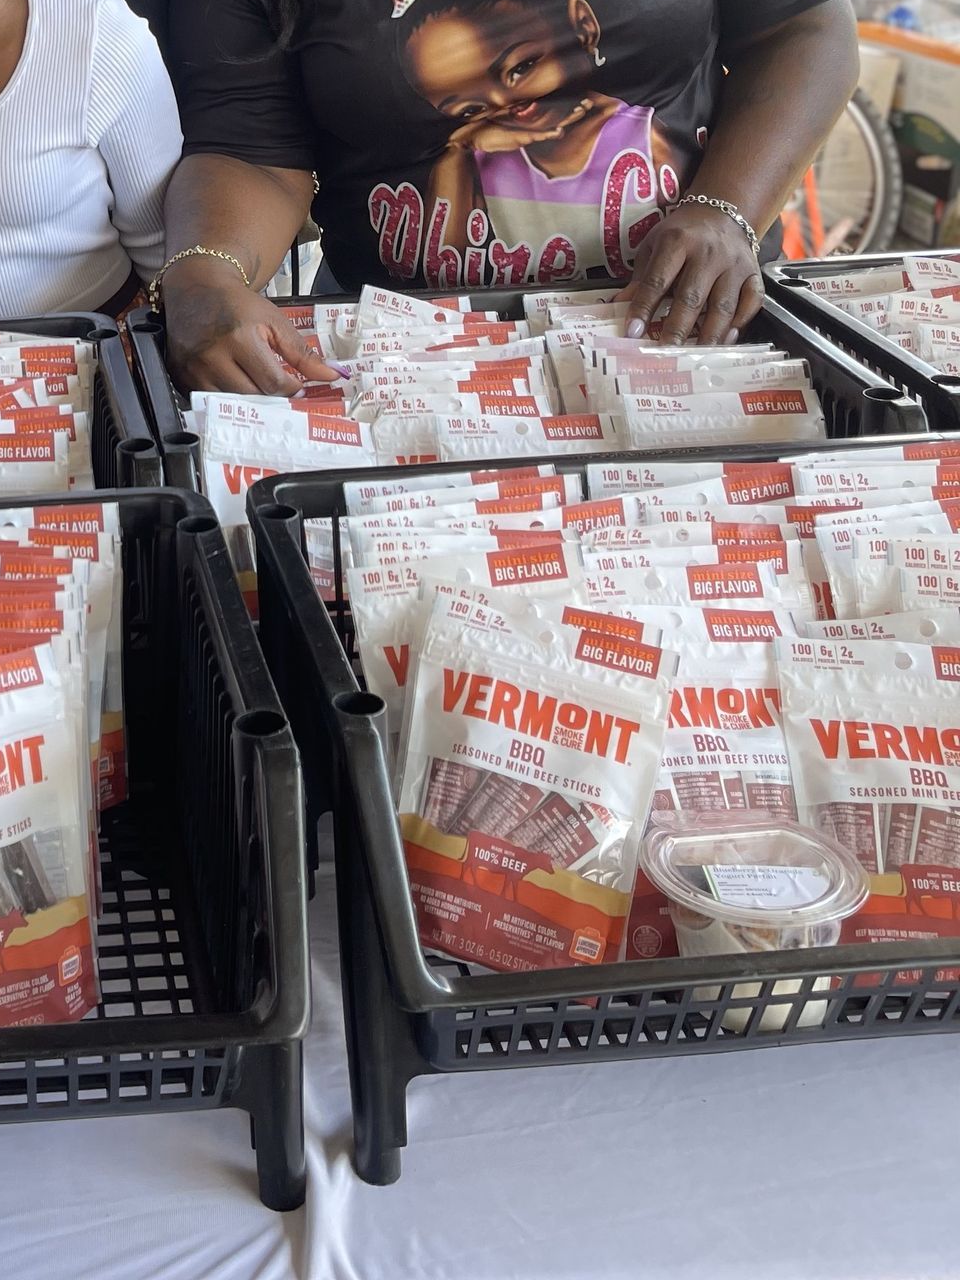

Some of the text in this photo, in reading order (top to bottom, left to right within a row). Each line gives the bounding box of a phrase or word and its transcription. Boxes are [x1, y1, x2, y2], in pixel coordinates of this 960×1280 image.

[485, 406, 536, 415] BIG FLAVOR
[747, 402, 803, 412] BIG FLAVOR
[312, 427, 358, 442] BIG FLAVOR
[548, 426, 598, 436] BIG FLAVOR
[15, 446, 50, 458] FLAVOR
[730, 482, 790, 504] BIG FLAVOR
[495, 561, 562, 582] BIG FLAVOR
[693, 570, 754, 580] mini size
[694, 580, 758, 595] BIG FLAVOR
[712, 624, 777, 638] BIG FLAVOR
[582, 645, 654, 674] BIG FLAVOR
[442, 668, 641, 765] VERMONT
[669, 687, 780, 729] RMONT
[552, 734, 583, 751] & CURE
[554, 726, 585, 742] SMOKE
[694, 734, 729, 753] BBQ
[809, 719, 960, 765] VERMO
[509, 739, 546, 767] BBQ
[660, 754, 787, 766] SONED MINI BEEF STICKS
[452, 743, 602, 798] SEASONED MINI BEEF STICKS
[910, 768, 948, 788] BBQ
[850, 787, 960, 800] SEASONED MINI BEE
[7, 817, 32, 840] STICKS
[474, 847, 528, 873] 100% BEEF
[504, 913, 511, 921] NO
[511, 916, 536, 932] ARTIFICIAL
[535, 934, 542, 942] OR
[543, 937, 565, 951] FLAVORS
[459, 939, 464, 949] 3
[466, 941, 476, 953] OZ
[476, 946, 484, 956] (6
[490, 949, 501, 960] 0.5
[502, 955, 513, 967] OZ
